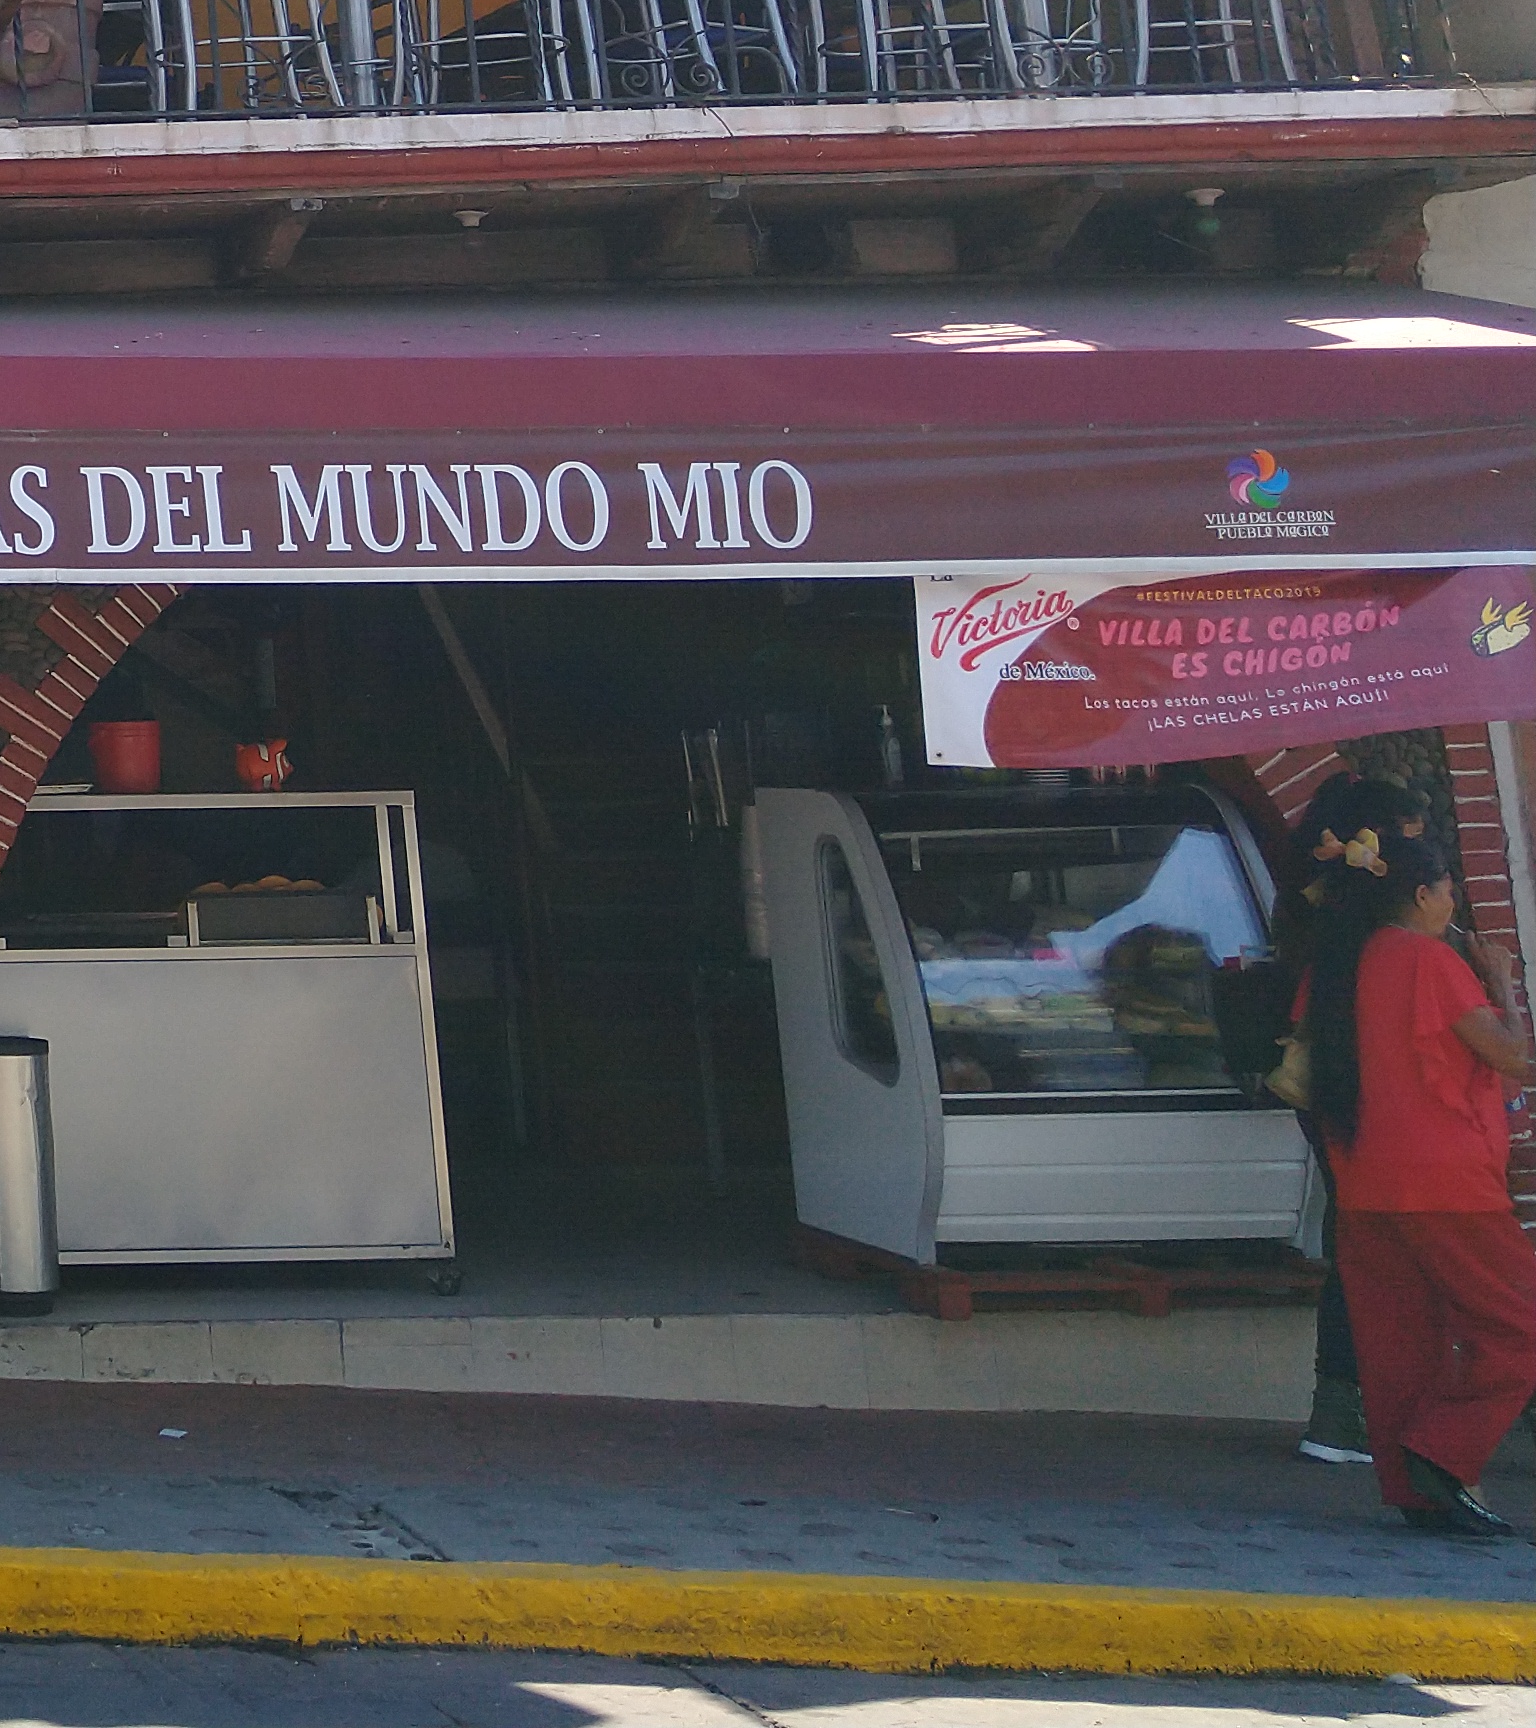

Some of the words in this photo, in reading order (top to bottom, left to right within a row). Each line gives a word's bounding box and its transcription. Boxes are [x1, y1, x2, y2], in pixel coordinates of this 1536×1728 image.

[80, 464, 251, 555] DEL
[270, 460, 609, 554] MUNDO
[637, 459, 813, 551] MIO
[1136, 586, 1321, 603] #FESTIVALDELTACO2019
[930, 574, 1074, 670] Victoria
[1098, 618, 1183, 647] VILLA
[1196, 617, 1254, 646] DEL
[1267, 600, 1402, 642] CARBÓN
[999, 663, 1020, 680] de
[1024, 662, 1096, 680] México.
[1171, 652, 1208, 680] ES
[1084, 696, 1110, 710] Los
[1114, 696, 1159, 710] tacos
[1164, 693, 1210, 708] están
[1192, 708, 1263, 727] CHELAS
